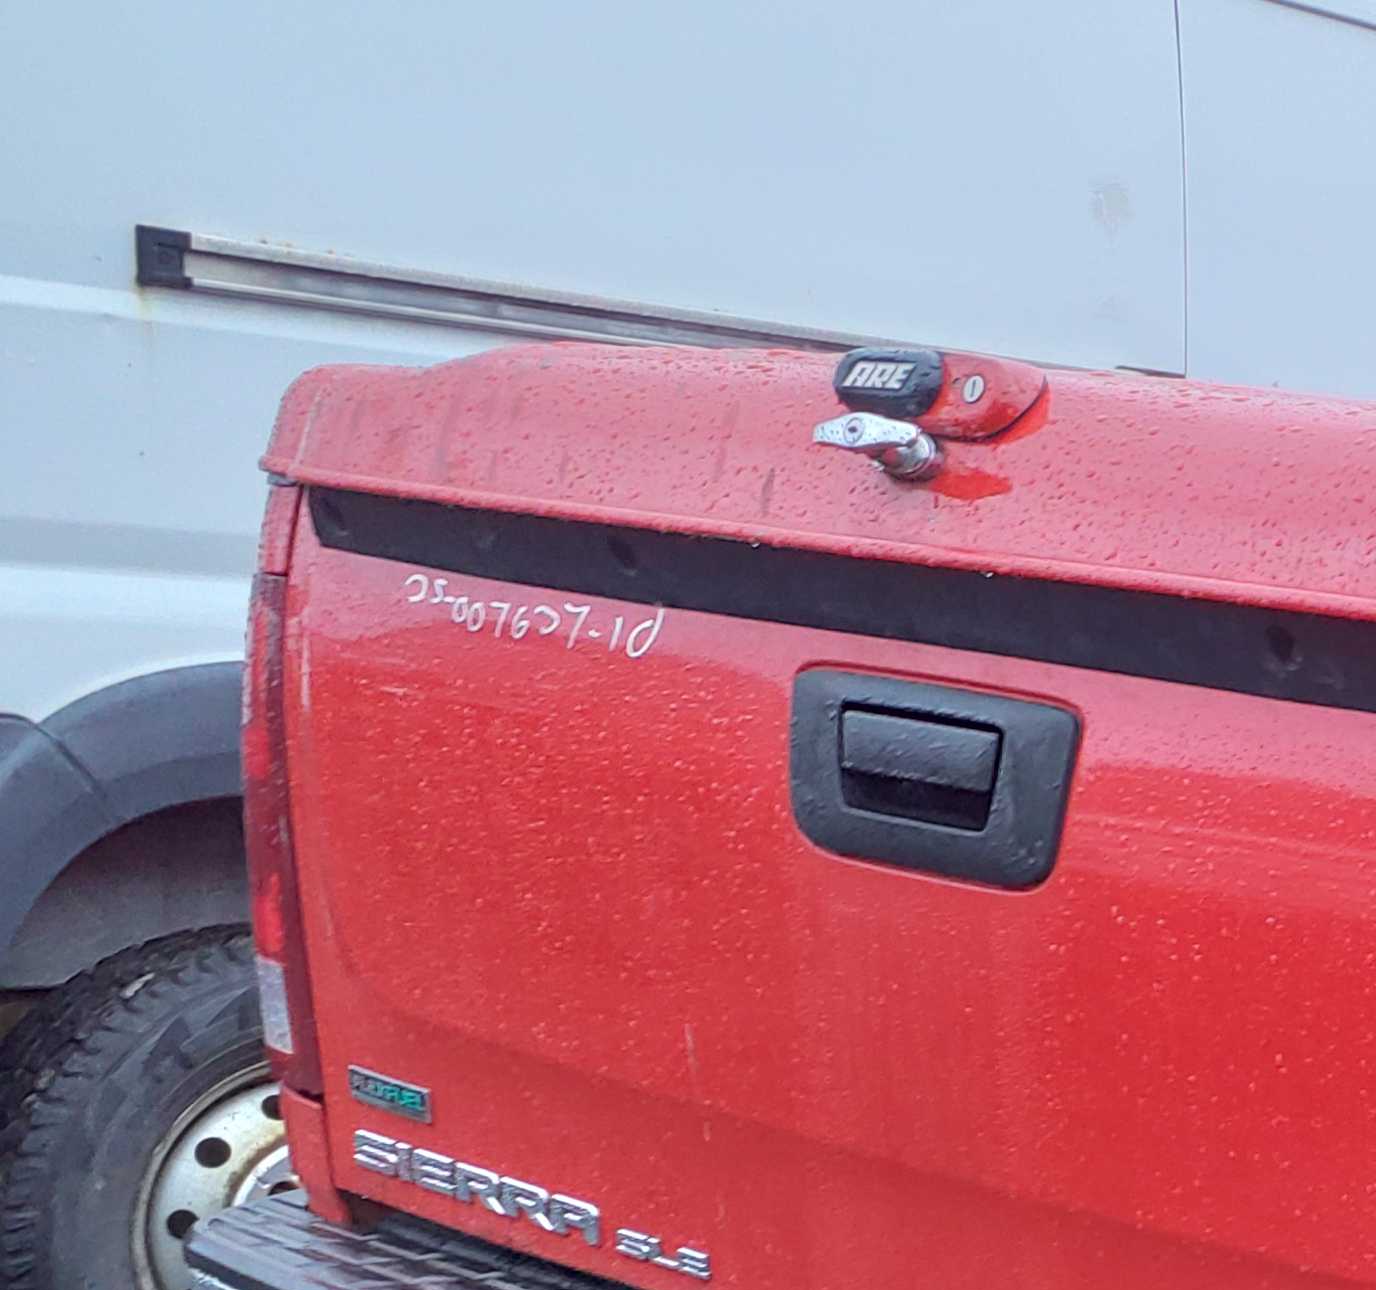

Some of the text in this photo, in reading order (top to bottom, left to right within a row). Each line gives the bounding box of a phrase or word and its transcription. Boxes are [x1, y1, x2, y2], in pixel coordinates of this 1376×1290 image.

[842, 361, 915, 390] ARE
[353, 1129, 711, 1280] SIERRA SLE
